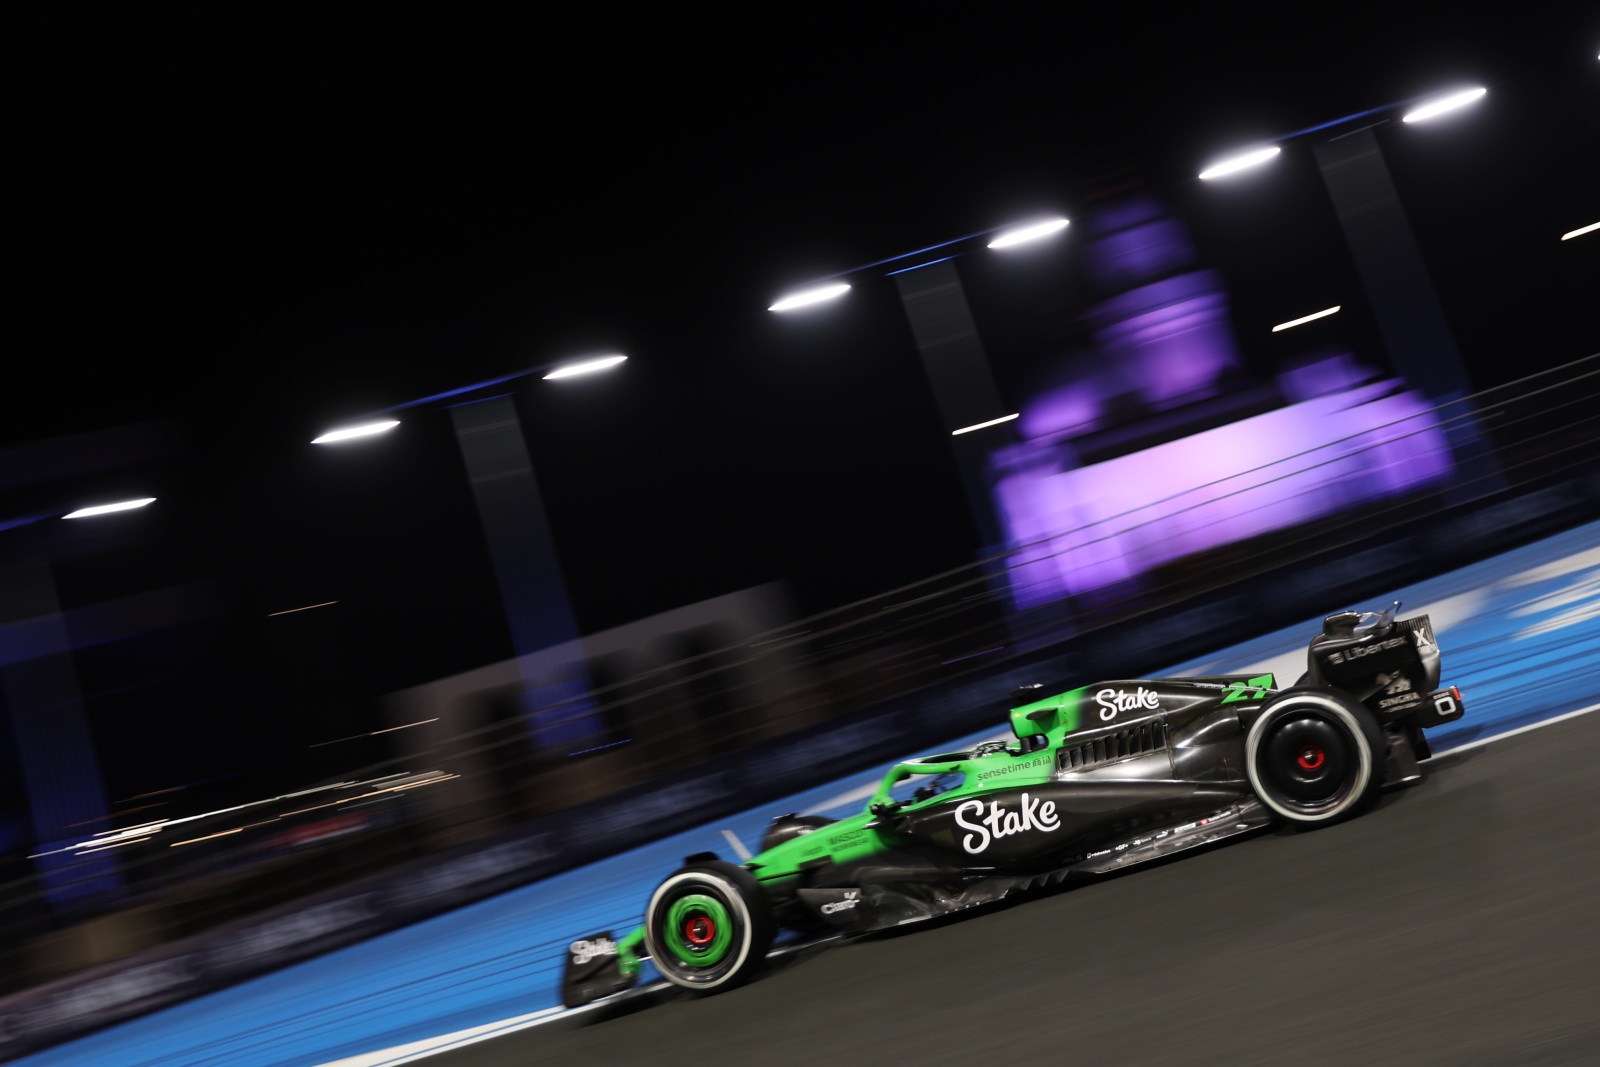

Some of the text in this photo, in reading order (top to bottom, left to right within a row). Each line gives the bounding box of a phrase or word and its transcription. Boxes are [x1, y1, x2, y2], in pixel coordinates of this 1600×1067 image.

[1096, 687, 1160, 721] Stake
[1221, 674, 1273, 704] 27
[977, 761, 1031, 781] sensetime
[955, 793, 1061, 855] Stake
